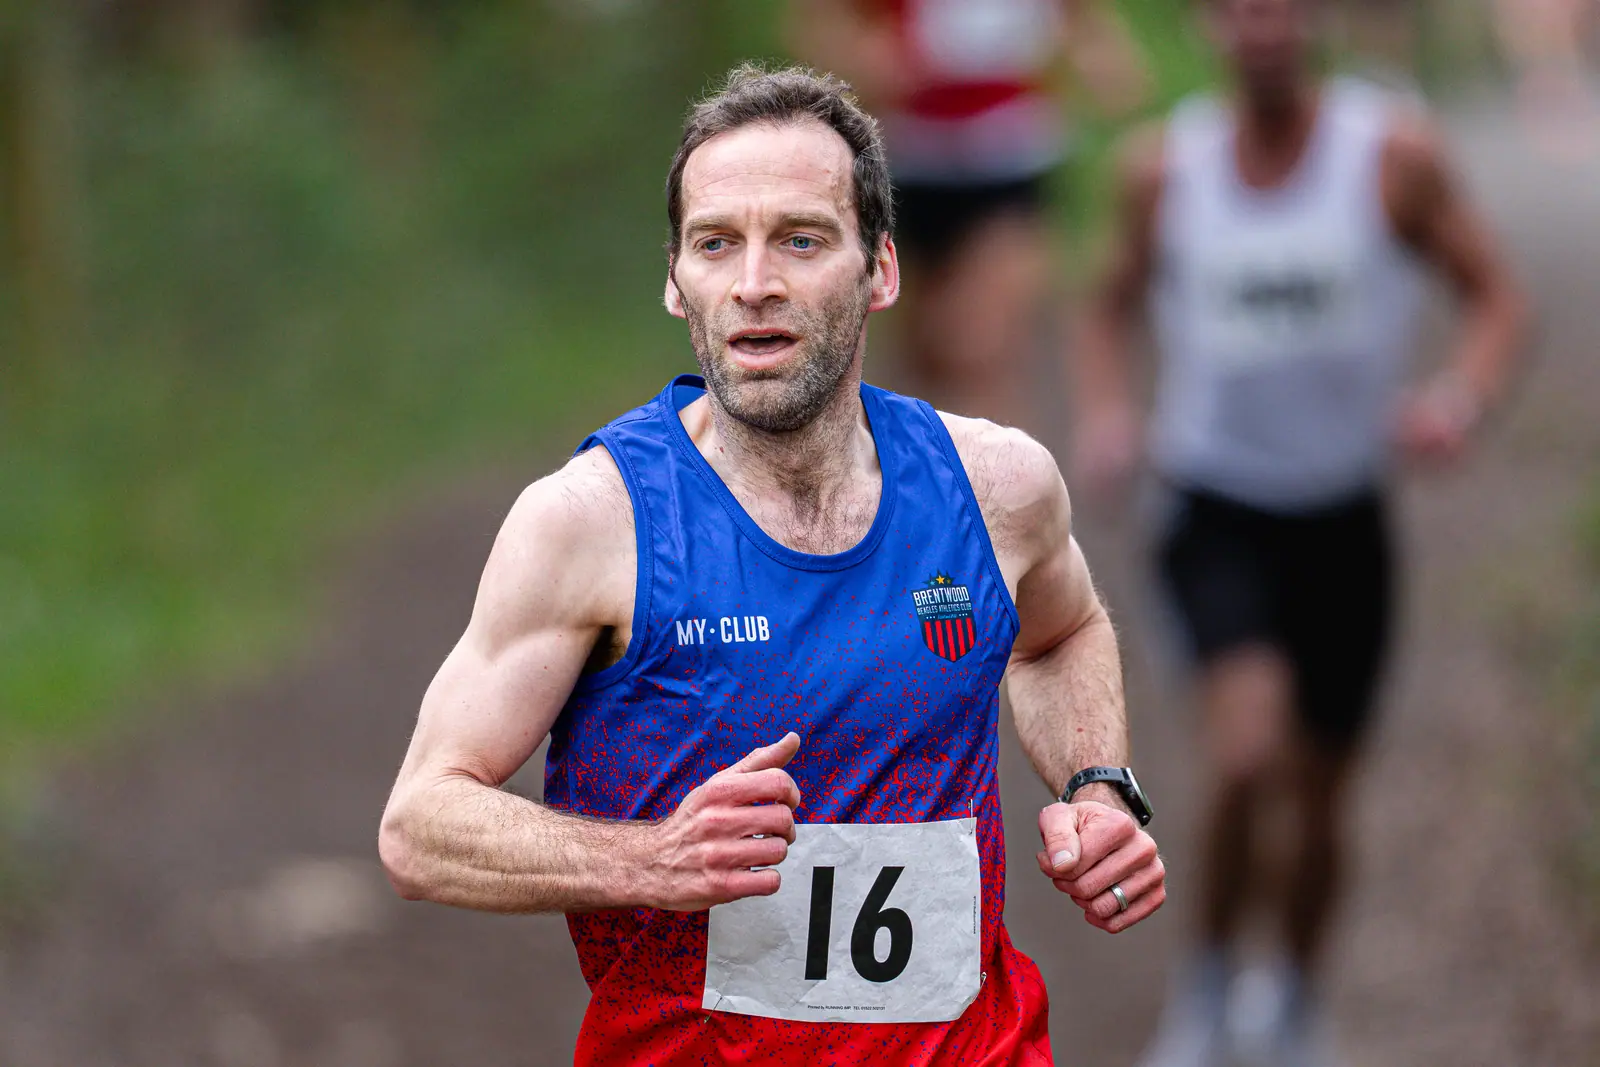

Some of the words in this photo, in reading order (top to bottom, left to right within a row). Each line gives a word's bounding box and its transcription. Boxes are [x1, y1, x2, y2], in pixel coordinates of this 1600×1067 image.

[912, 586, 970, 606] BRENTWOOD
[916, 605, 938, 615] BEAGLES
[938, 603, 960, 613] ATHLETICS
[960, 602, 972, 611] CLUB
[804, 865, 913, 983] 16
